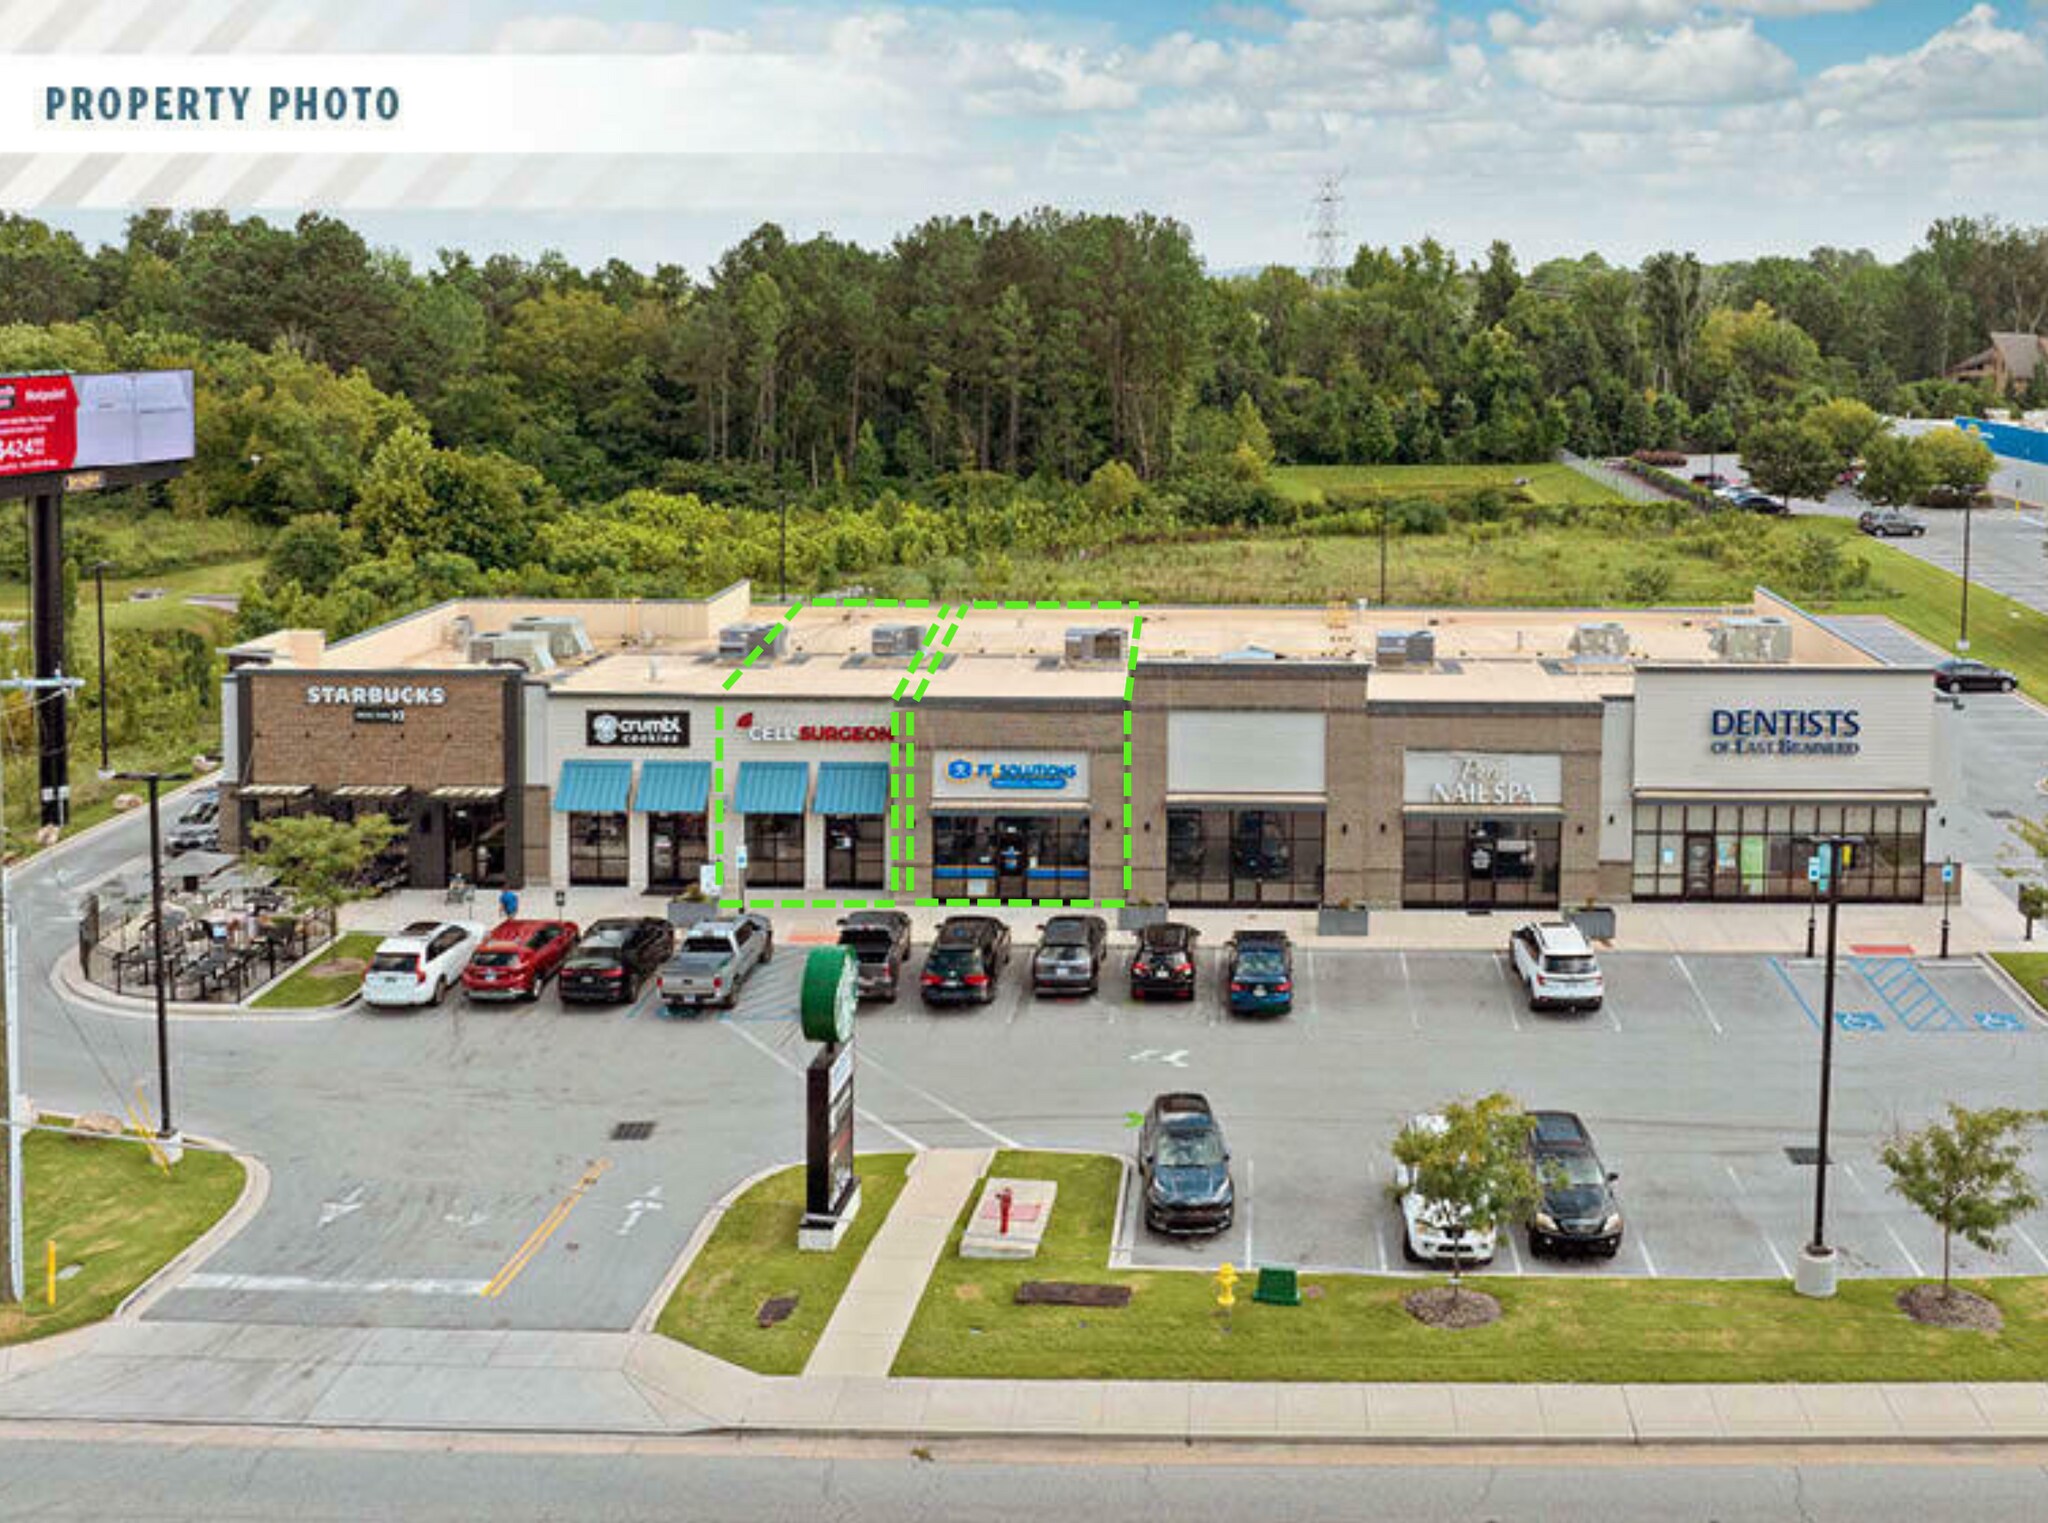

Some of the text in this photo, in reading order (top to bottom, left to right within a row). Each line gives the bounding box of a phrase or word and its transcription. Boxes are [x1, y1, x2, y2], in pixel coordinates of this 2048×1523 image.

[307, 684, 446, 705] STARBUCKS
[619, 716, 682, 733] crumbl
[797, 726, 894, 742] SURGEON
[1712, 710, 1860, 737] DENTISTS
[1431, 782, 1537, 803] NAIL SPA
